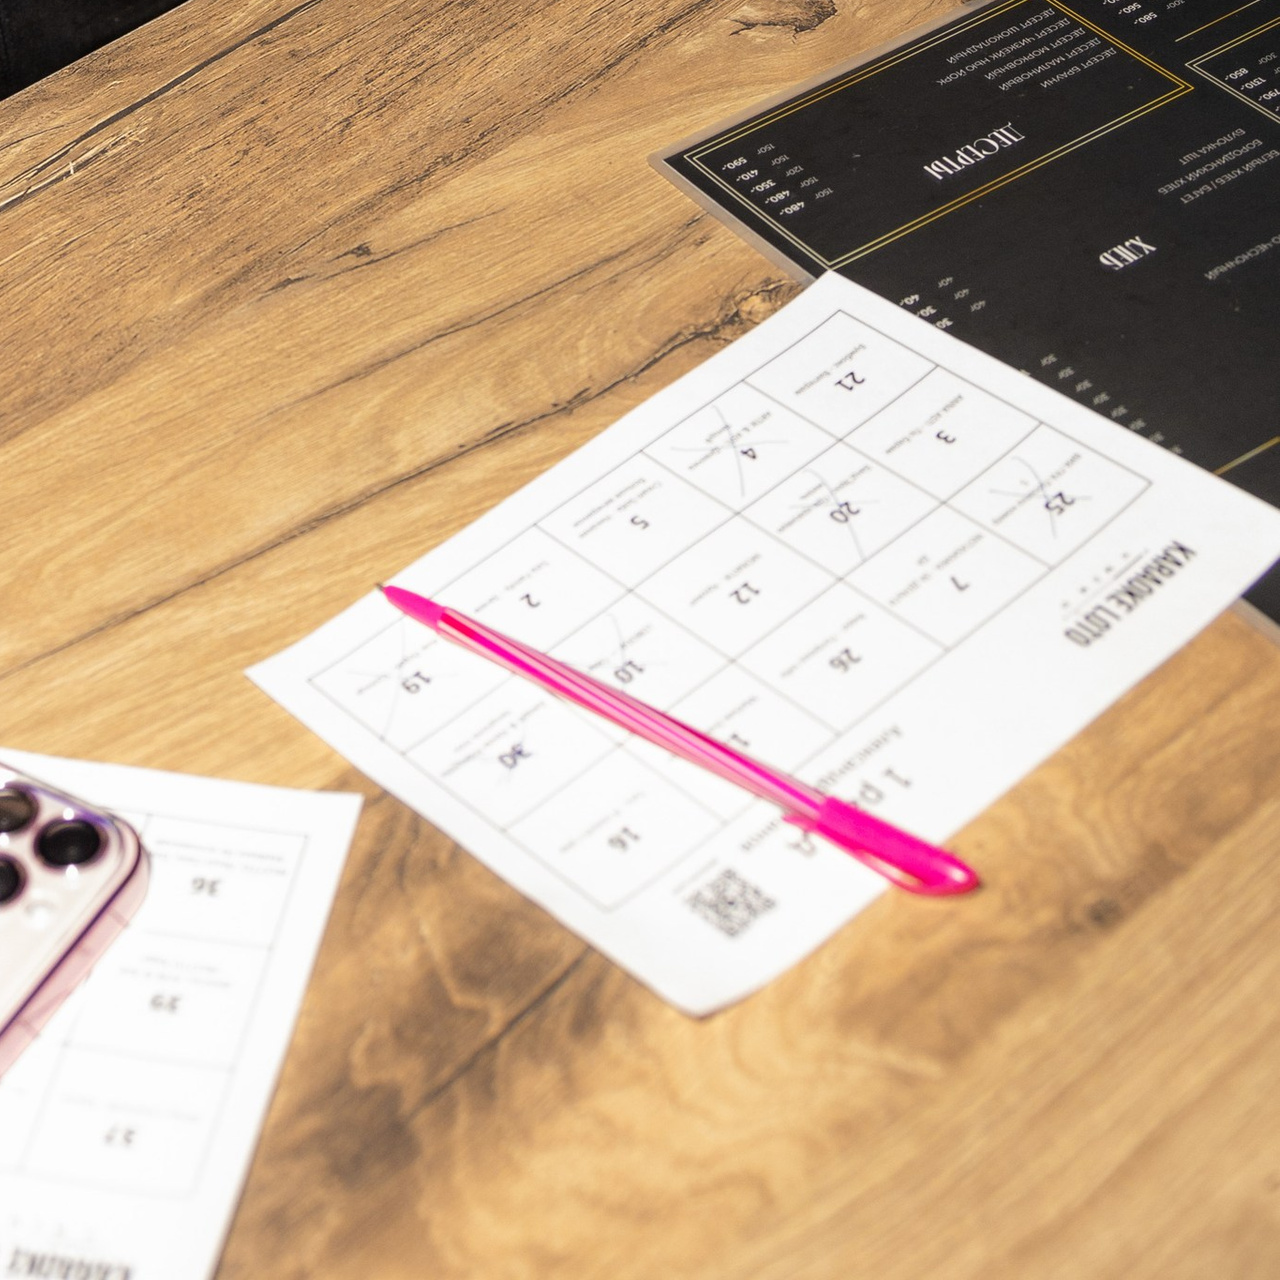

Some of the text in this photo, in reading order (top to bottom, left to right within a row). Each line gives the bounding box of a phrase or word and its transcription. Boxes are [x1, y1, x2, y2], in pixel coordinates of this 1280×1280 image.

[945, 7, 1055, 64] ДЕСЕРТ ШОКОЛАДНЫЙ
[935, 16, 1071, 86] ДЕСЕРТ ЧИЗКЕЙК НЬЮ ЙОРК
[983, 26, 1086, 80] ДЕСЕРТ МОРКОВНЫЙ
[997, 36, 1101, 91] ДЕСЕРТ МАЛИНОВЫЙ
[1039, 46, 1117, 88] ДЕСЕРТ БРАУНИ
[923, 123, 1024, 180] ДЕСЕРТЫ
[1196, 127, 1246, 154] БУЛОЧКА
[1156, 138, 1263, 195] БОРОДИНСКИЙ ХЛЕБ
[1240, 148, 1280, 172] БЕЛЫЙ
[1214, 167, 1244, 185] ХЛЕБ
[1179, 183, 1213, 204] БАГЕТ
[1098, 235, 1156, 270] ХЛЕБ
[834, 370, 865, 391] 21
[934, 429, 956, 444] 3
[739, 446, 757, 460] 4
[828, 500, 860, 524] 20
[1043, 490, 1075, 514] 25
[629, 514, 650, 530] 5
[949, 575, 970, 592] 7
[1108, 538, 1198, 611] KARAOKE
[519, 592, 540, 608] 2
[729, 581, 760, 605] 12
[1063, 604, 1119, 646] LOTO
[612, 659, 644, 684] 10
[828, 647, 861, 672] 26
[400, 670, 431, 694] 19
[607, 825, 640, 851] 16
